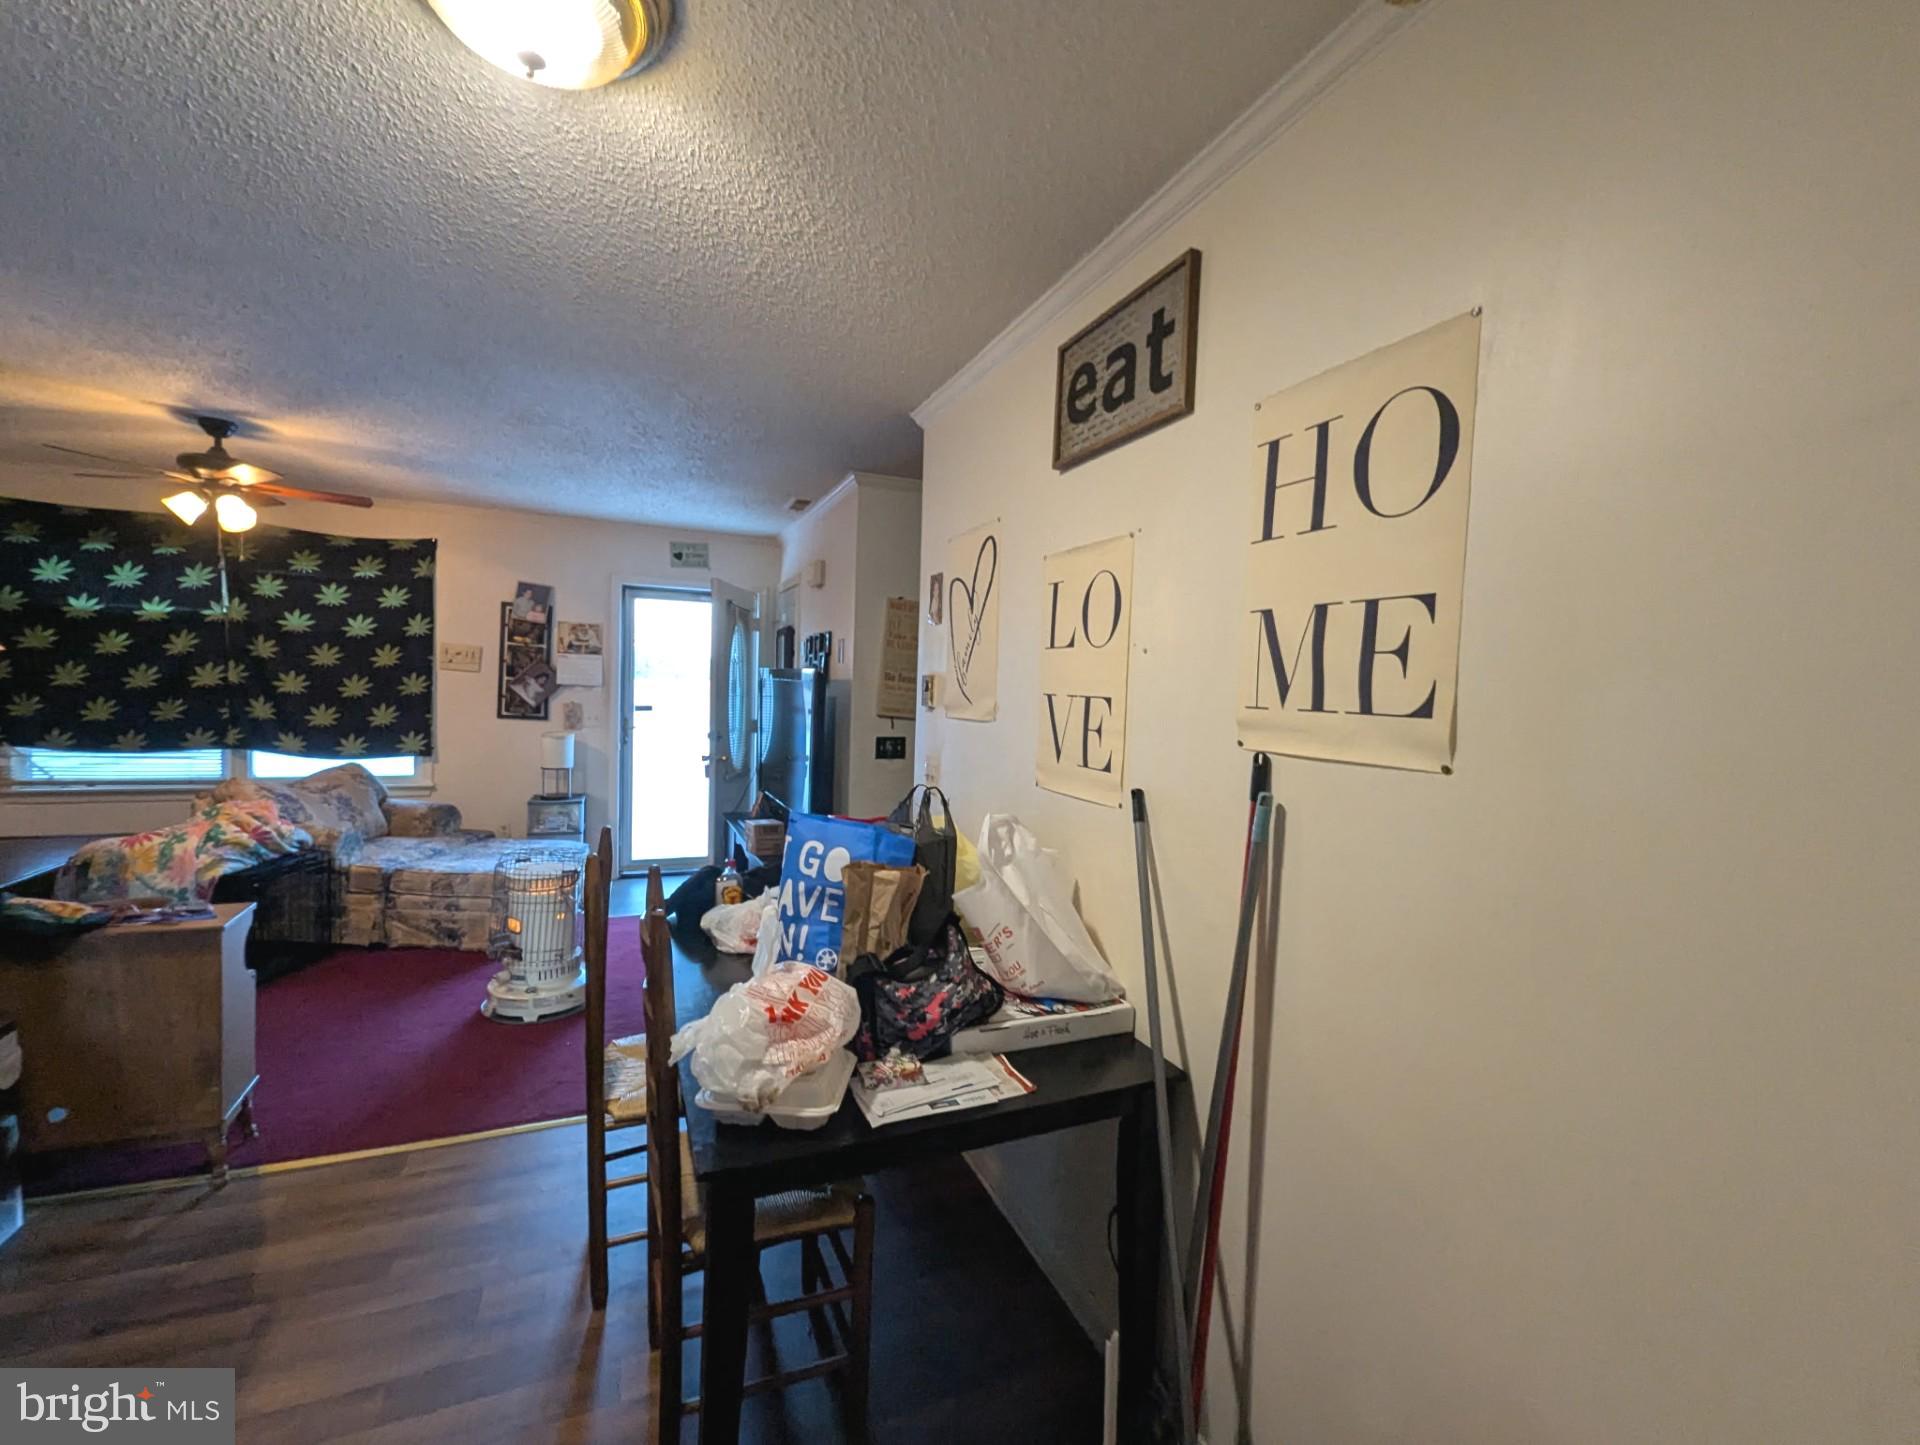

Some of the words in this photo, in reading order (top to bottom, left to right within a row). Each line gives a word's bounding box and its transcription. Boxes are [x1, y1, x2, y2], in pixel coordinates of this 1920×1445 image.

[1067, 306, 1175, 424] eat
[1251, 385, 1460, 544] HO
[1045, 570, 1122, 650] LO
[1245, 592, 1437, 719] ME
[1043, 693, 1112, 773] VE
[798, 840, 850, 882] GO
